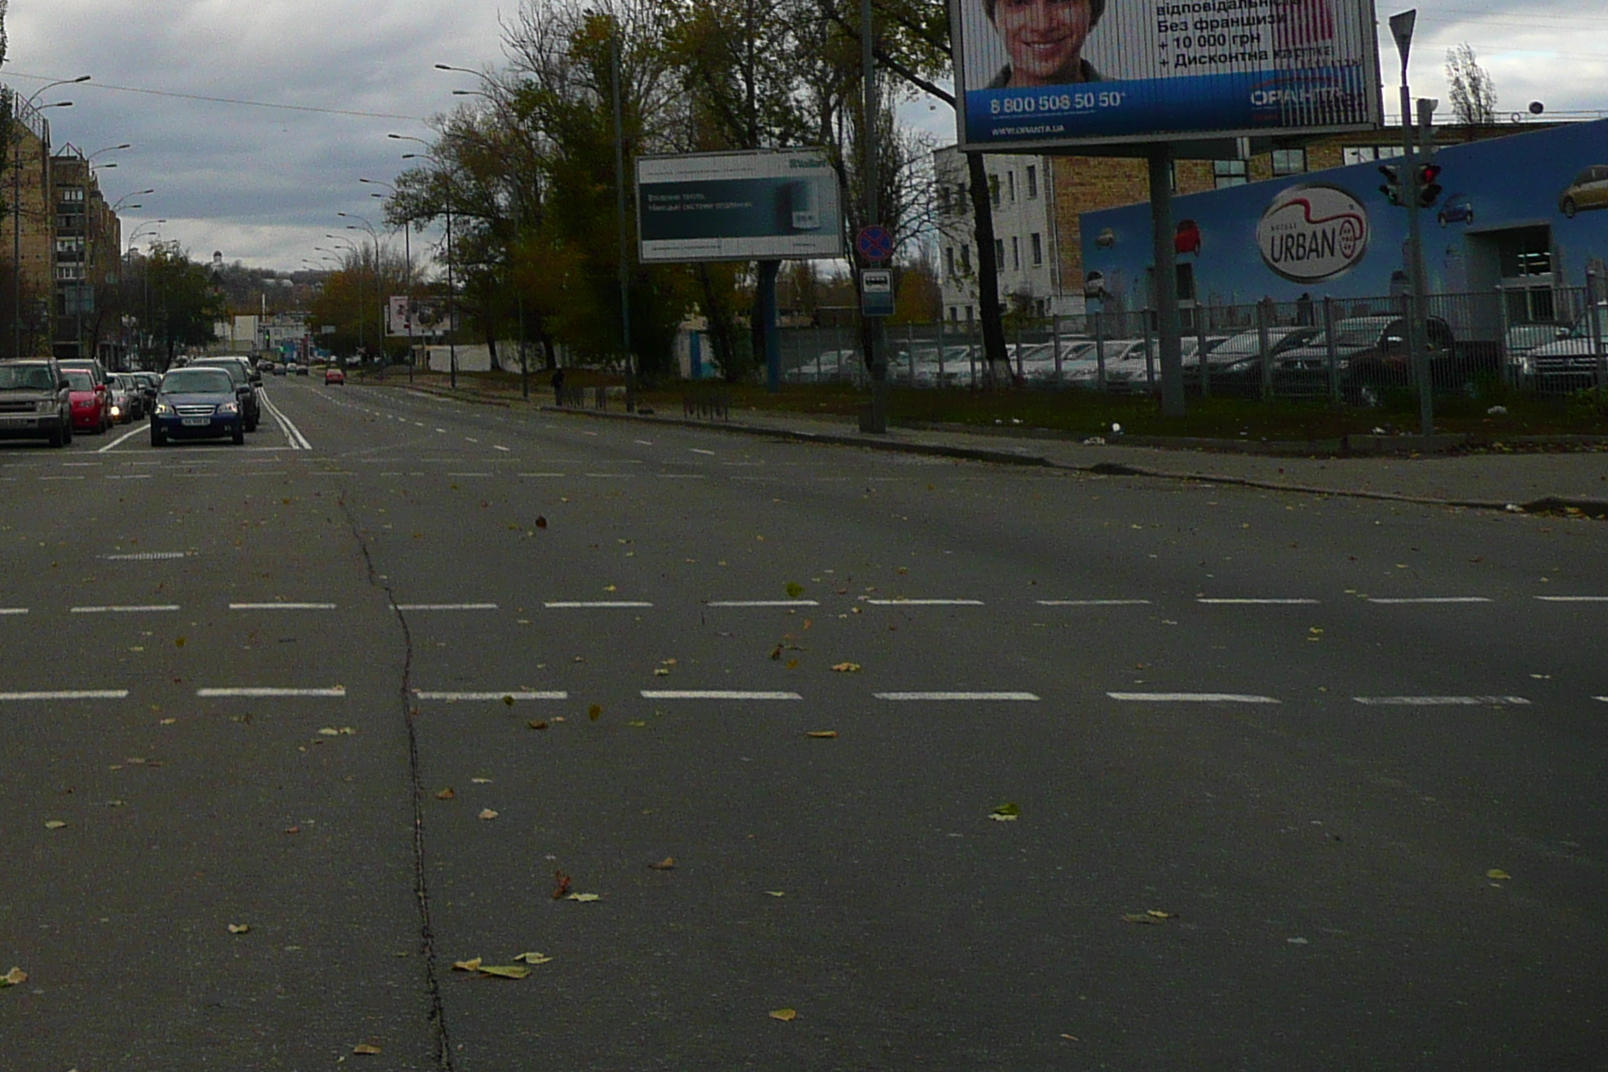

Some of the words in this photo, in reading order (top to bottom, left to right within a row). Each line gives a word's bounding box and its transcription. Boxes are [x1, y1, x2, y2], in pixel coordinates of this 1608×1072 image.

[1158, 20, 1188, 33] Без
[1194, 13, 1287, 33] франшизи
[1174, 36, 1192, 49] 10
[1198, 34, 1226, 48] 000
[1232, 32, 1261, 48] грн
[1174, 49, 1268, 69] Дисконтна
[990, 99, 1001, 114] 8
[1004, 96, 1035, 113] 800
[1038, 94, 1071, 111] 508
[1074, 91, 1095, 108] 50
[1270, 227, 1336, 263] URBAN
